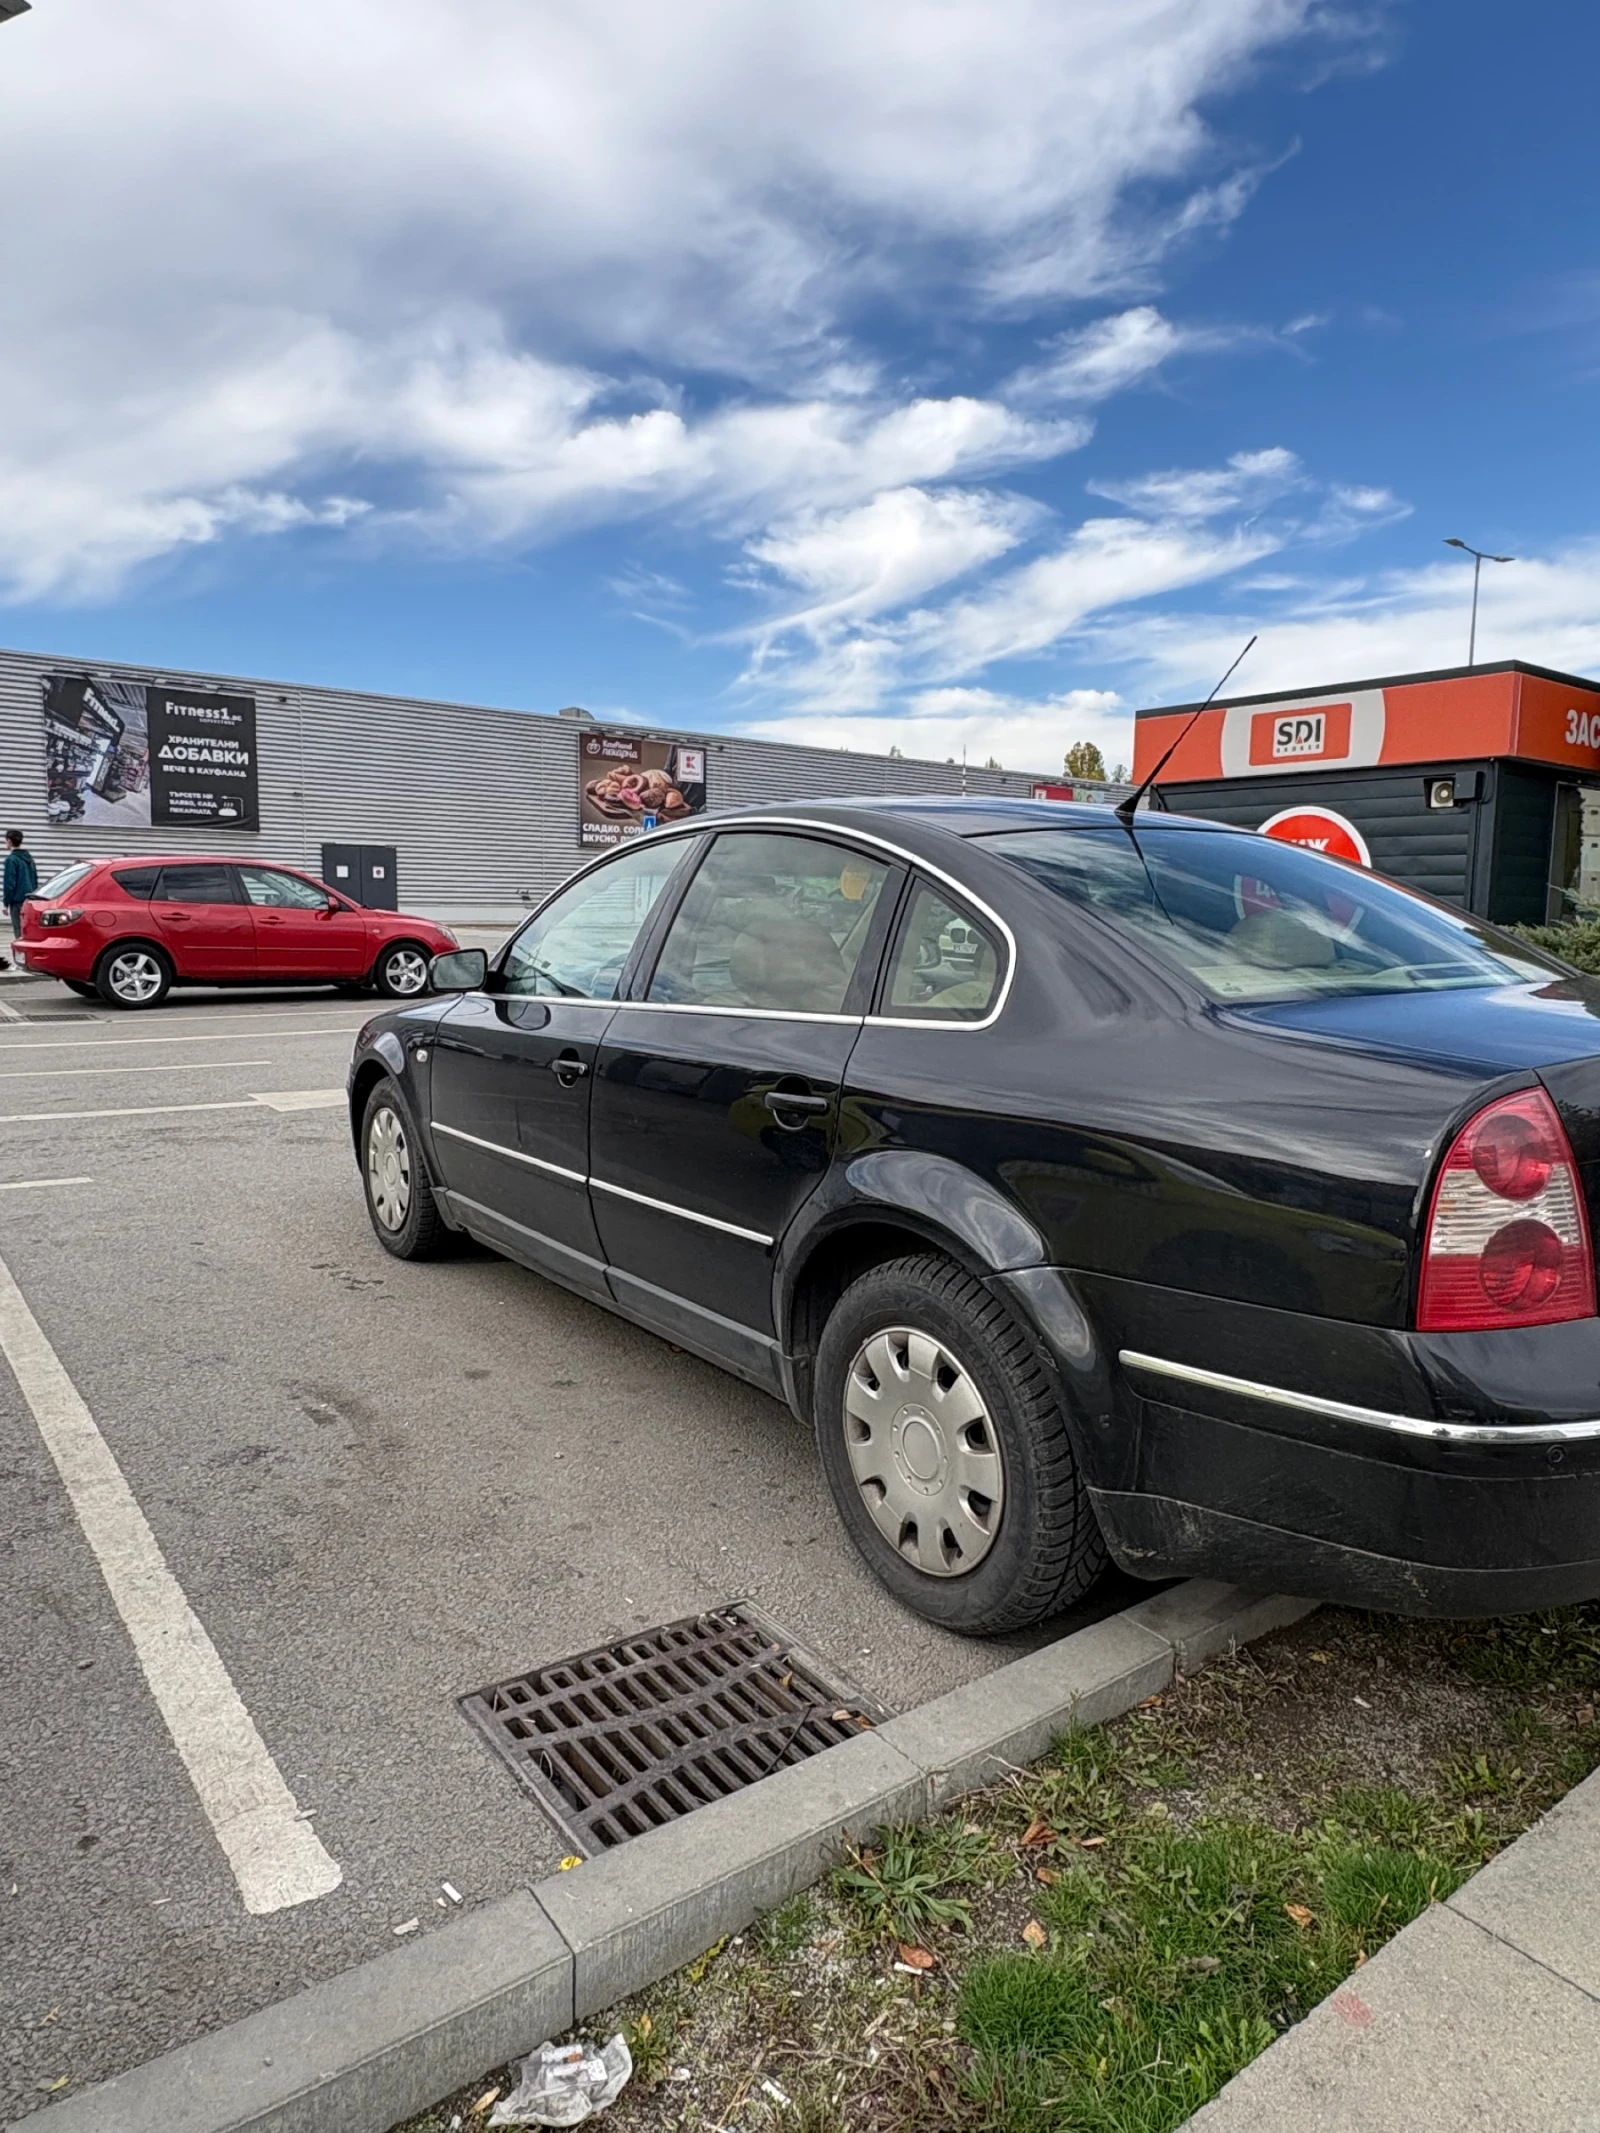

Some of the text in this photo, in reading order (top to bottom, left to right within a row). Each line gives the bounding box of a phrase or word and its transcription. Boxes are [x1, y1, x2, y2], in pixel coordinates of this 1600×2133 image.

[1277, 718, 1322, 746] SDI
[167, 735, 240, 749] ХРАНИТЕЛНИ
[157, 744, 249, 765] ДОБАВКИ
[162, 764, 187, 773] ВЕЧЕ
[196, 767, 248, 778] КАУФЛАНД
